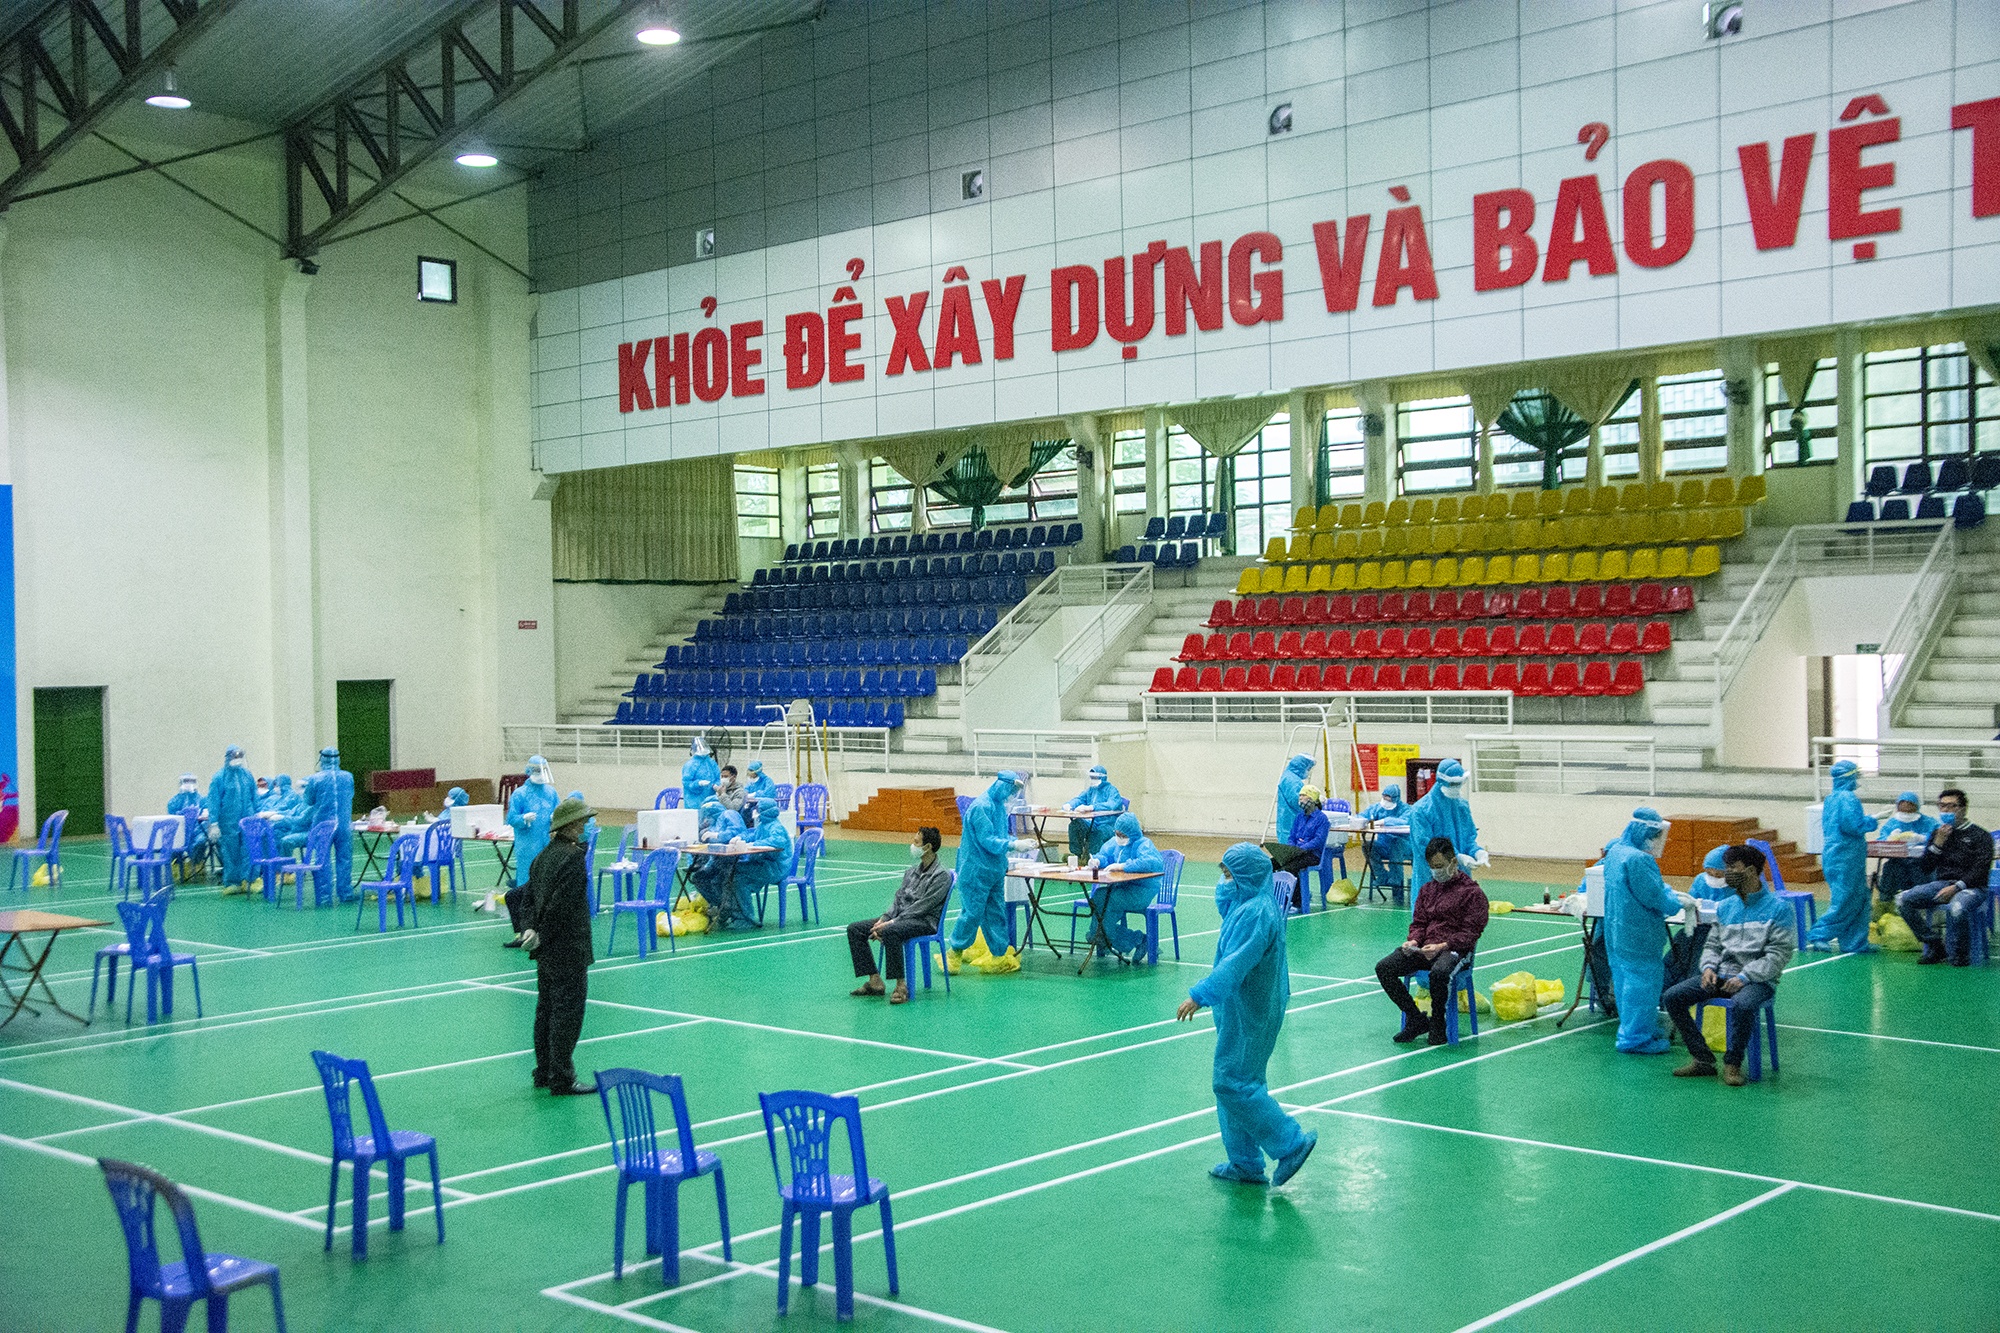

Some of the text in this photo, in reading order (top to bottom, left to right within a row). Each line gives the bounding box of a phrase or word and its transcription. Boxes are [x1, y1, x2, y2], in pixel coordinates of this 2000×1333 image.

[618, 296, 765, 413] KHỎE
[783, 258, 865, 390] ĐỂ
[885, 265, 1026, 376] XÂY
[1050, 231, 1284, 359] DỰNG
[1312, 185, 1440, 313] VÀ
[1473, 122, 1696, 292] BẢO
[1738, 94, 1902, 260] VỆ
